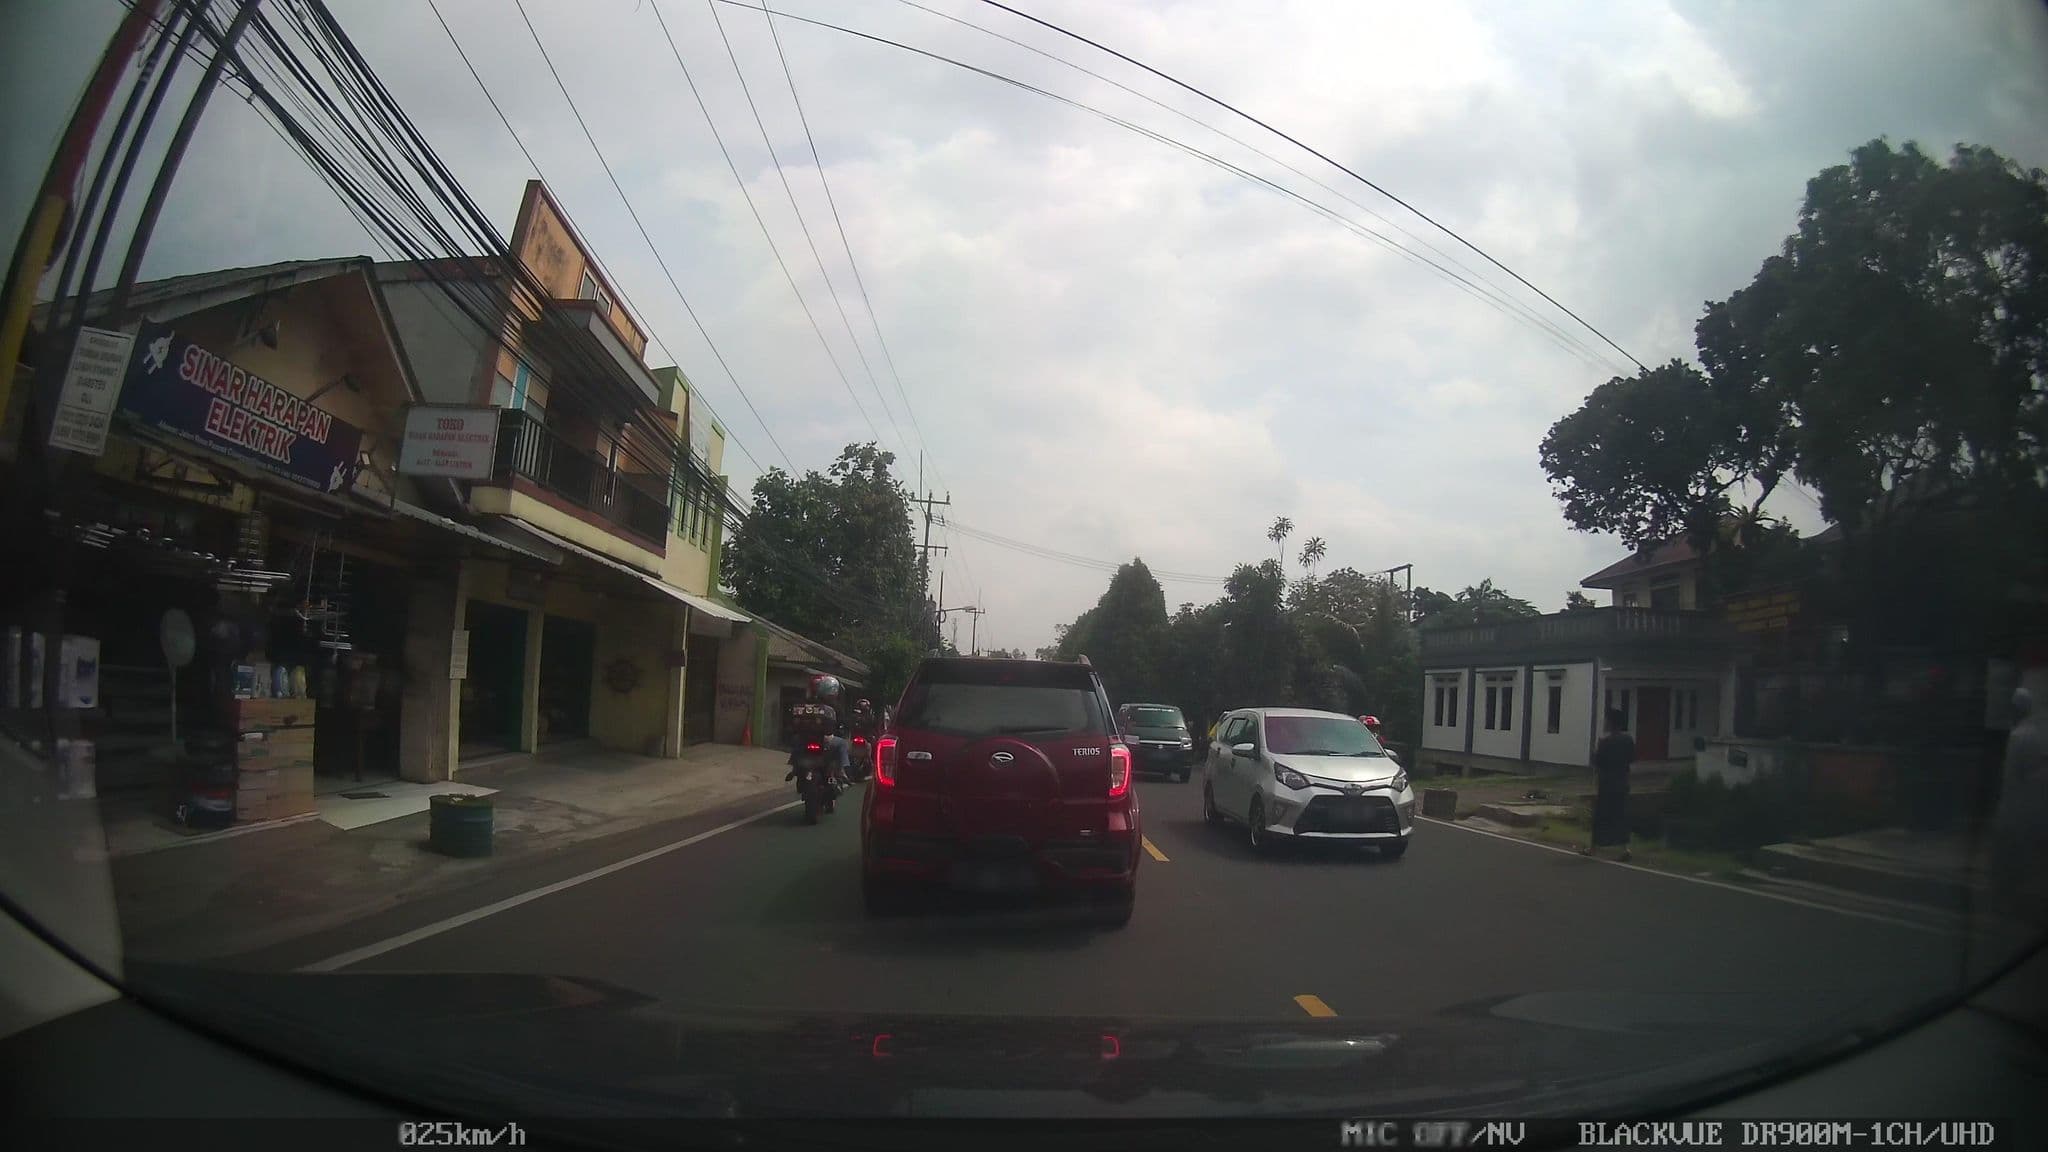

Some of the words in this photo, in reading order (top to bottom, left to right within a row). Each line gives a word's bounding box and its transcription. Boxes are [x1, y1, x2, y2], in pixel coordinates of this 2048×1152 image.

[180, 344, 246, 406] SINAR
[244, 376, 332, 444] HARAPAN
[204, 397, 296, 464] ELEKTRIK
[438, 417, 465, 431] TOKO
[1072, 747, 1101, 756] TERIOS
